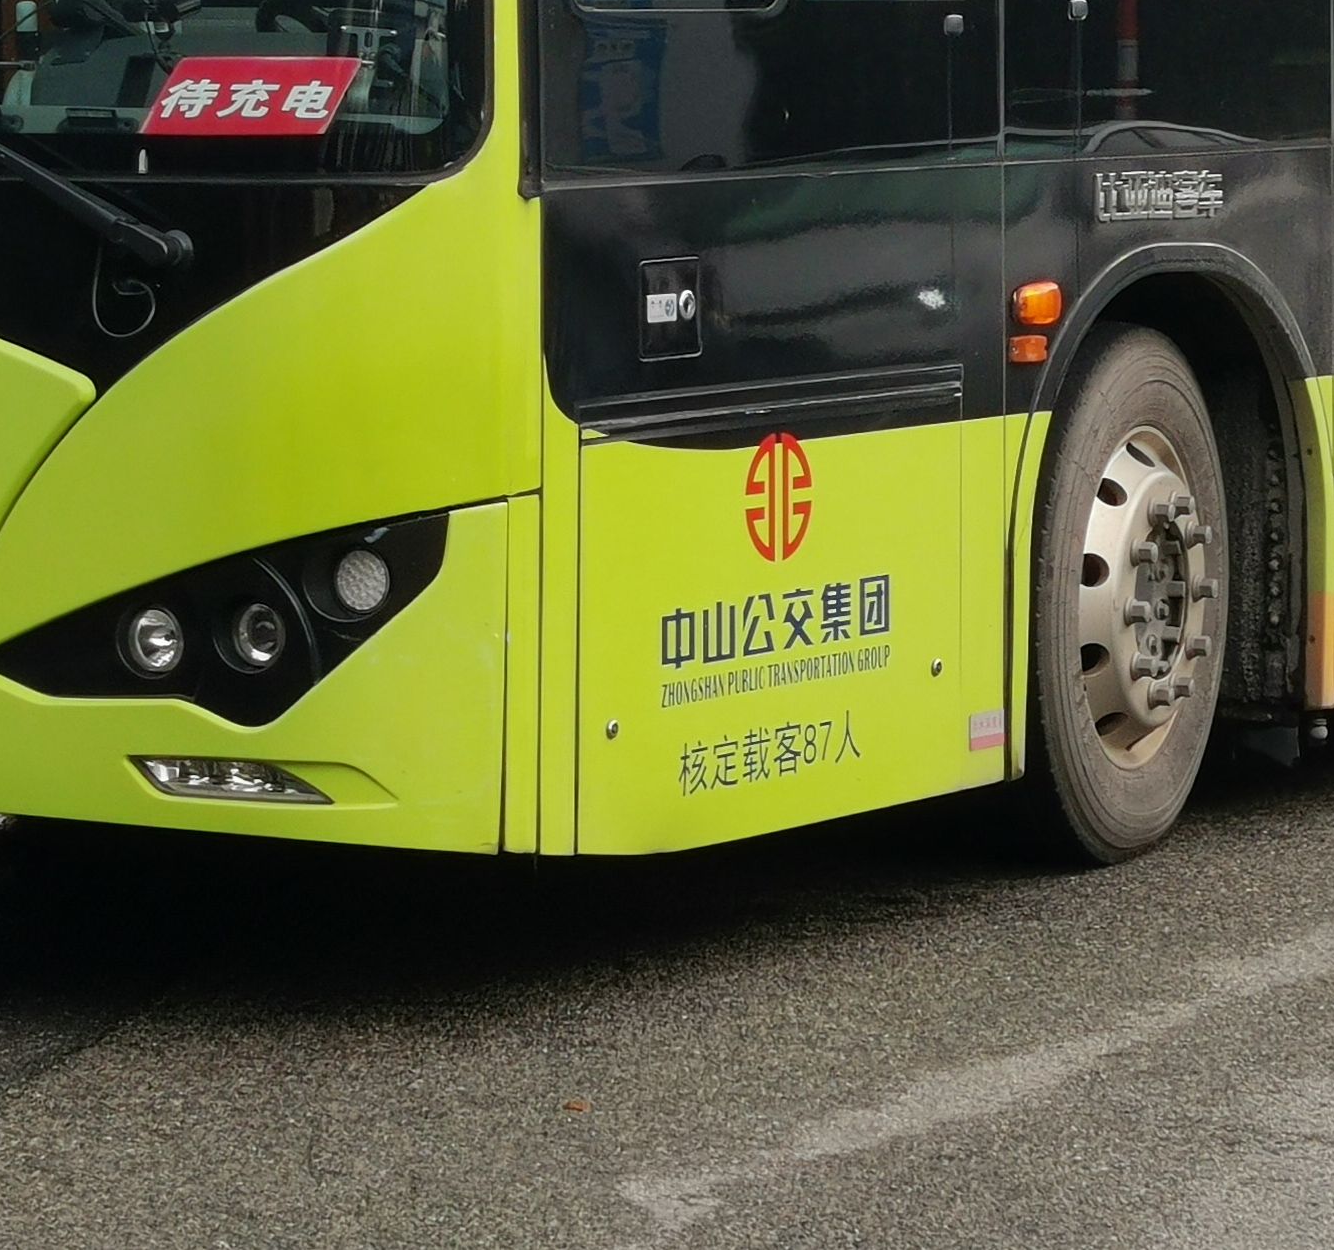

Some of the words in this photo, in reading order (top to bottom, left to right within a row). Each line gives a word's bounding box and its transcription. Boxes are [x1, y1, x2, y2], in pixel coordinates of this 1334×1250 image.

[160, 79, 335, 119] 待充电
[1094, 170, 1224, 223] 比亚迪客车
[661, 574, 891, 669] 中山公交集团
[661, 675, 726, 708] ZHONGSHAN
[728, 664, 765, 695] PUBLIC
[768, 652, 855, 688] TRANSPORTATION
[857, 644, 891, 671] GROUP
[678, 710, 862, 797] 核定载客87人
